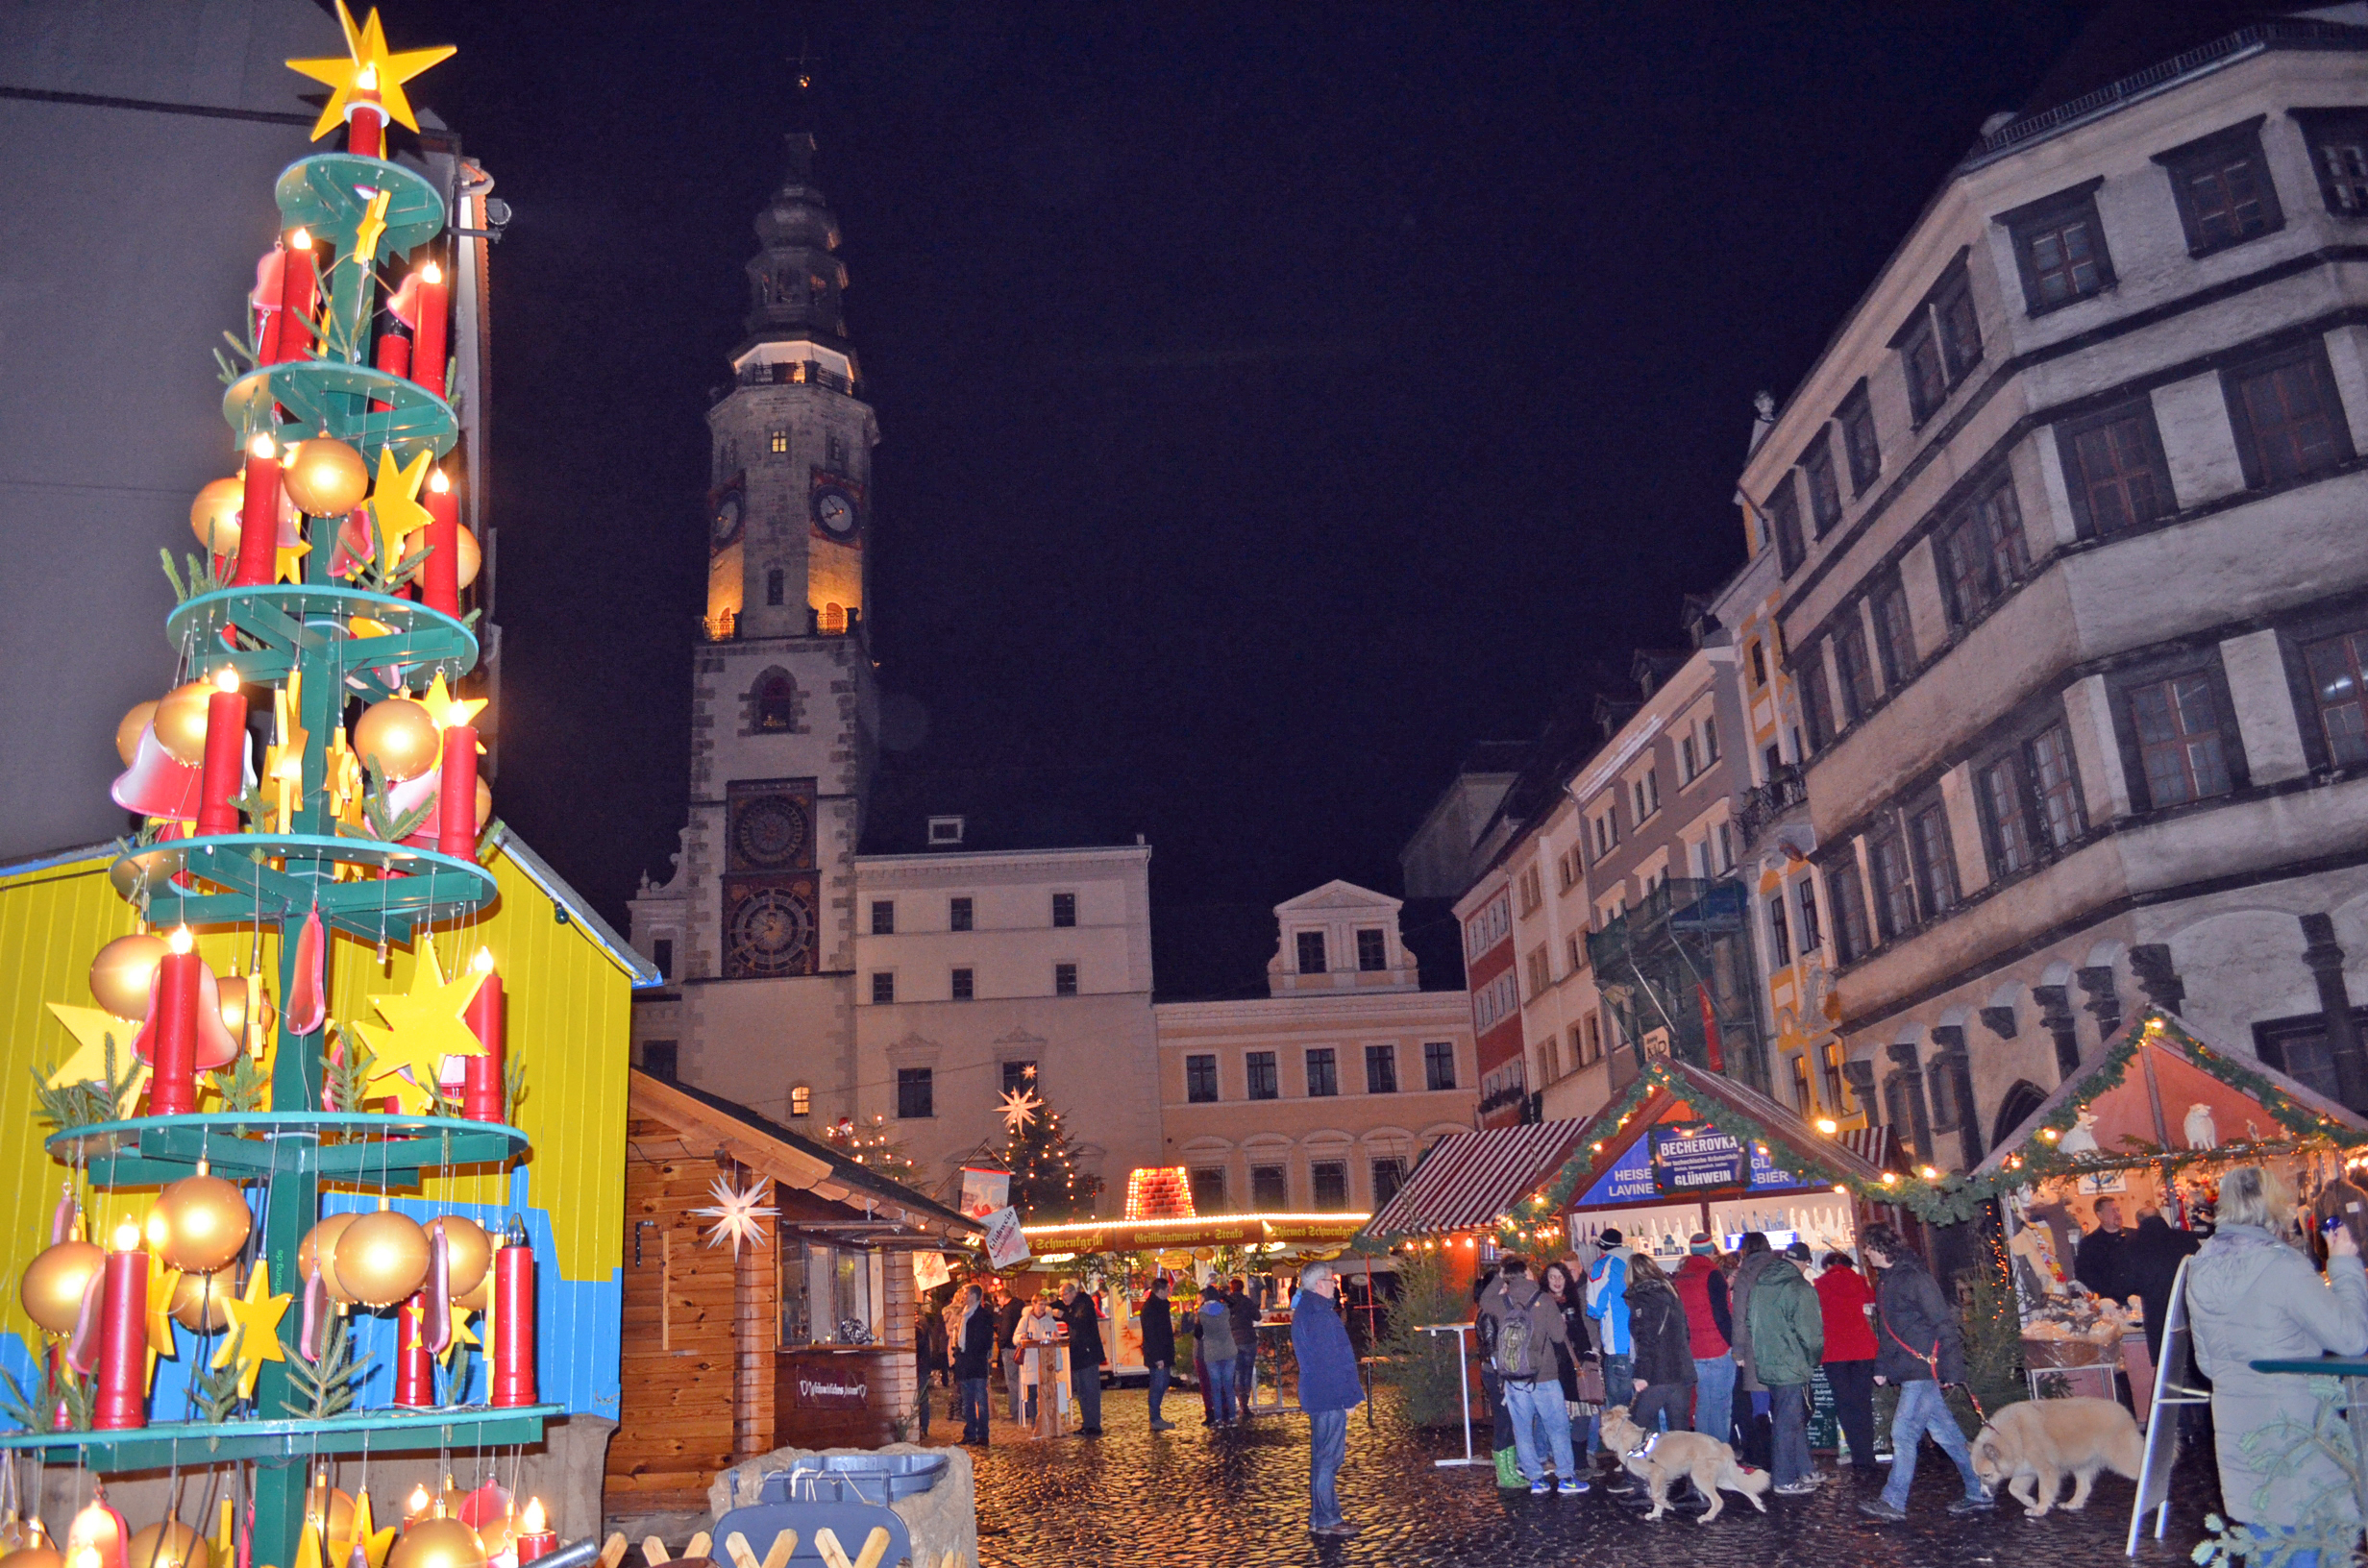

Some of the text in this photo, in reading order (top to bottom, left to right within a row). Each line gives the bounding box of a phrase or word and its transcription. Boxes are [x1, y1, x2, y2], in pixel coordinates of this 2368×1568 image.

[1661, 1136, 1739, 1156] BECHEROVKA
[1615, 1167, 1653, 1182] HEISE
[1674, 1169, 1732, 1186] GLÜHWEIN
[1609, 1183, 1654, 1197] LAVINE
[989, 1211, 1013, 1250] Glühwein
[1134, 1232, 1200, 1243] Grillbratwurst
[1215, 1228, 1244, 1239] Steaks
[1035, 1235, 1103, 1250] Schwenkgrill
